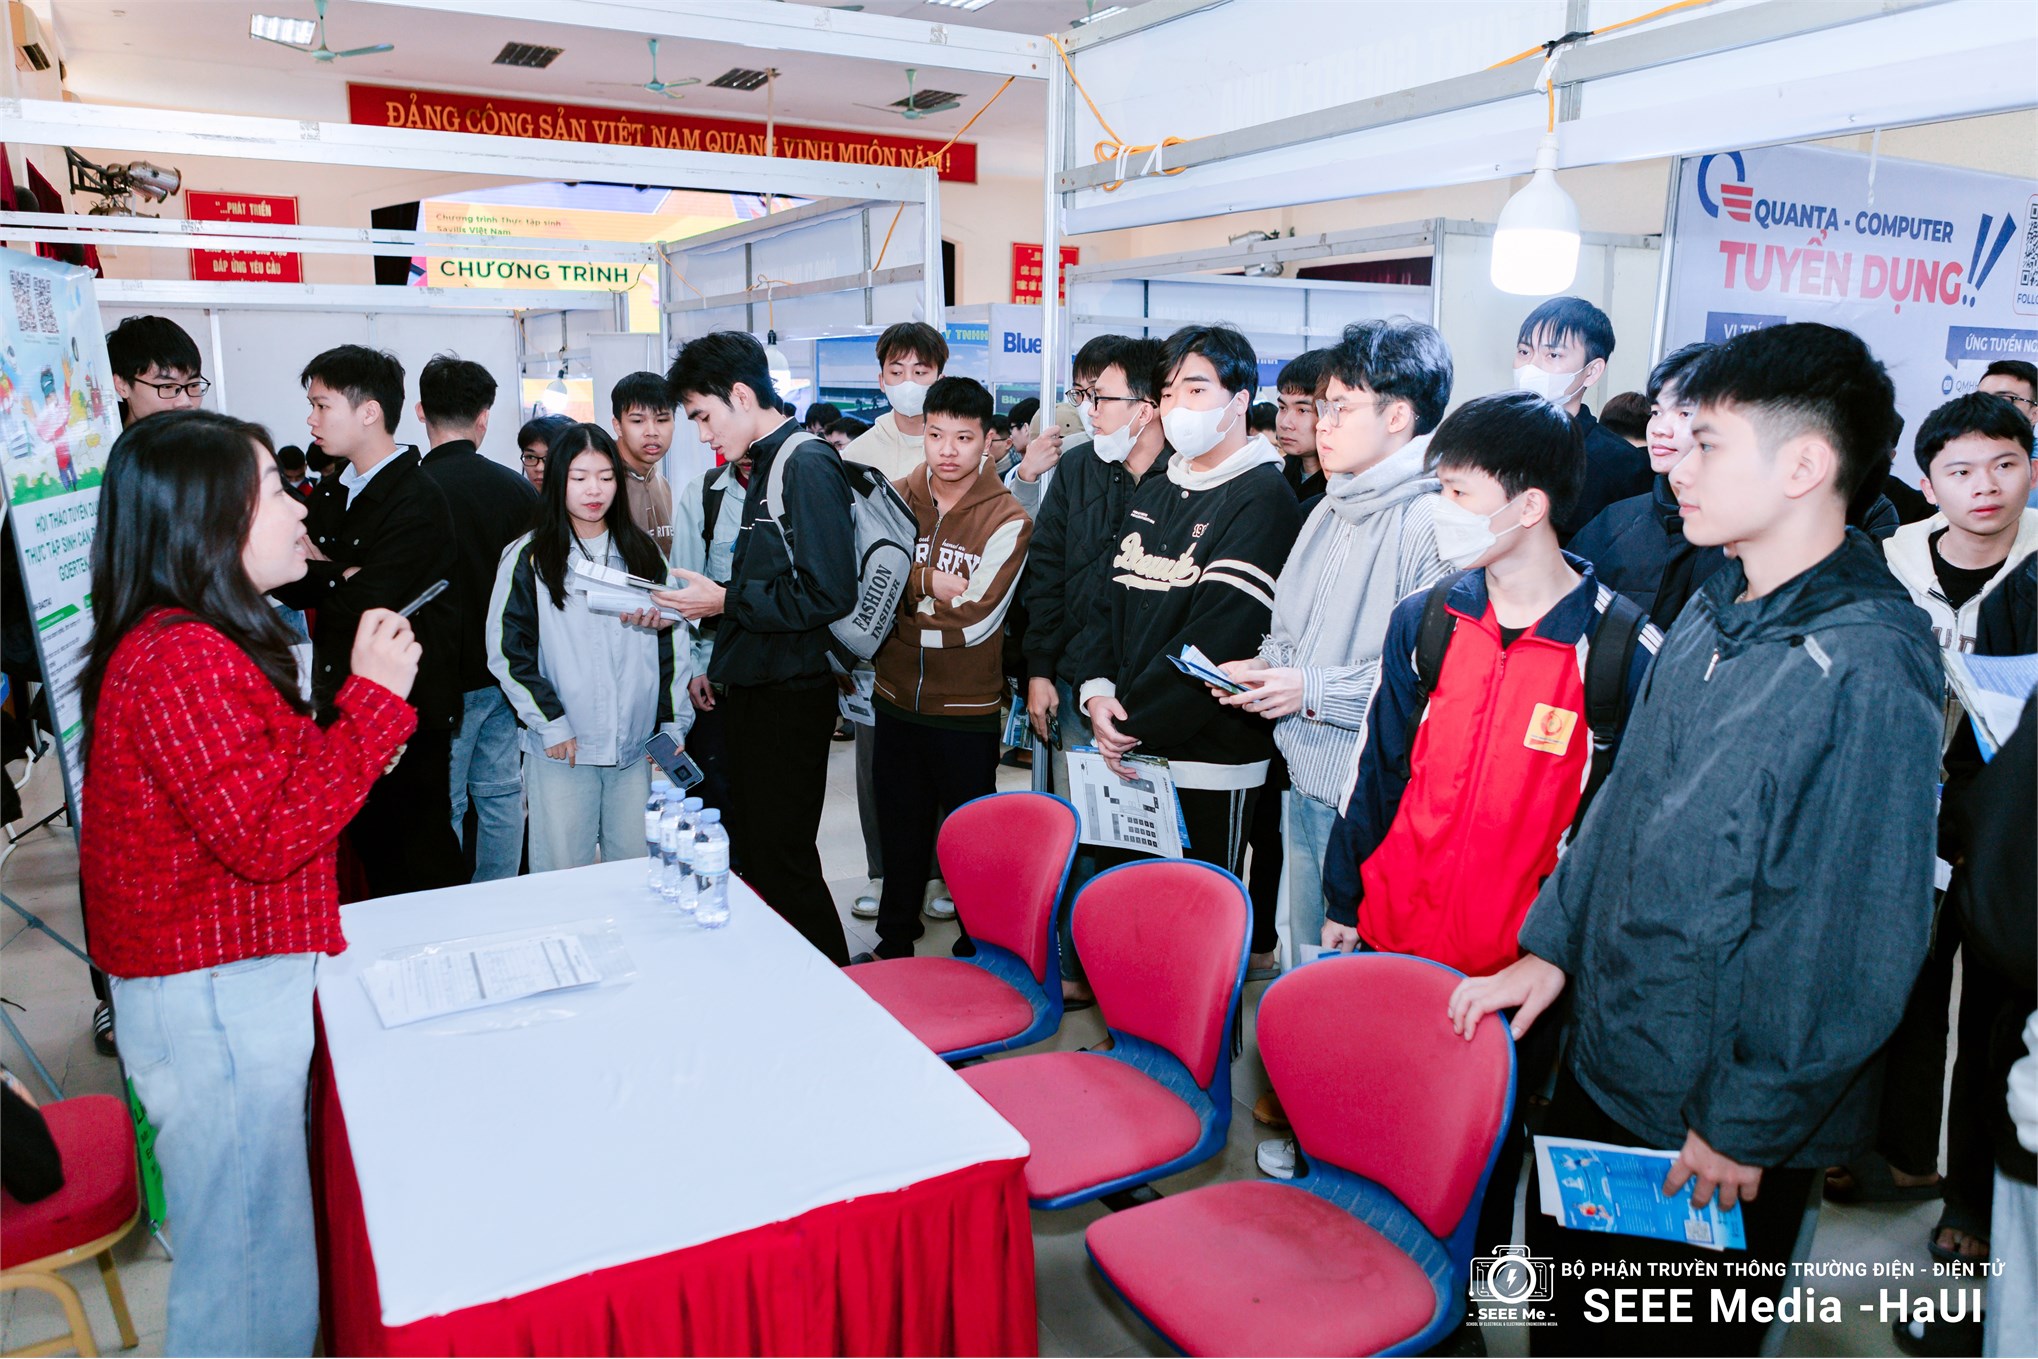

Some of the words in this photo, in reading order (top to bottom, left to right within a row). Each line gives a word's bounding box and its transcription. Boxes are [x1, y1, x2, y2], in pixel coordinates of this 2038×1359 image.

[386, 93, 460, 132] ĐẢNG
[466, 103, 534, 139] CÔNG
[539, 107, 587, 143] SẢN
[651, 127, 700, 151] NAM
[782, 137, 834, 162] VINH
[838, 139, 896, 167] MUÔN
[1755, 199, 1839, 231] QUANTA
[1855, 211, 1954, 243] COMPUTER
[440, 259, 550, 280] CHƯƠNG
[558, 262, 629, 283] TRÌNH
[1719, 229, 1853, 299] TUYỂN
[1965, 333, 1989, 351] ỨNG
[2023, 337, 2038, 353] NG
[852, 563, 893, 632] FASHION
[871, 578, 901, 640] INSIDER
